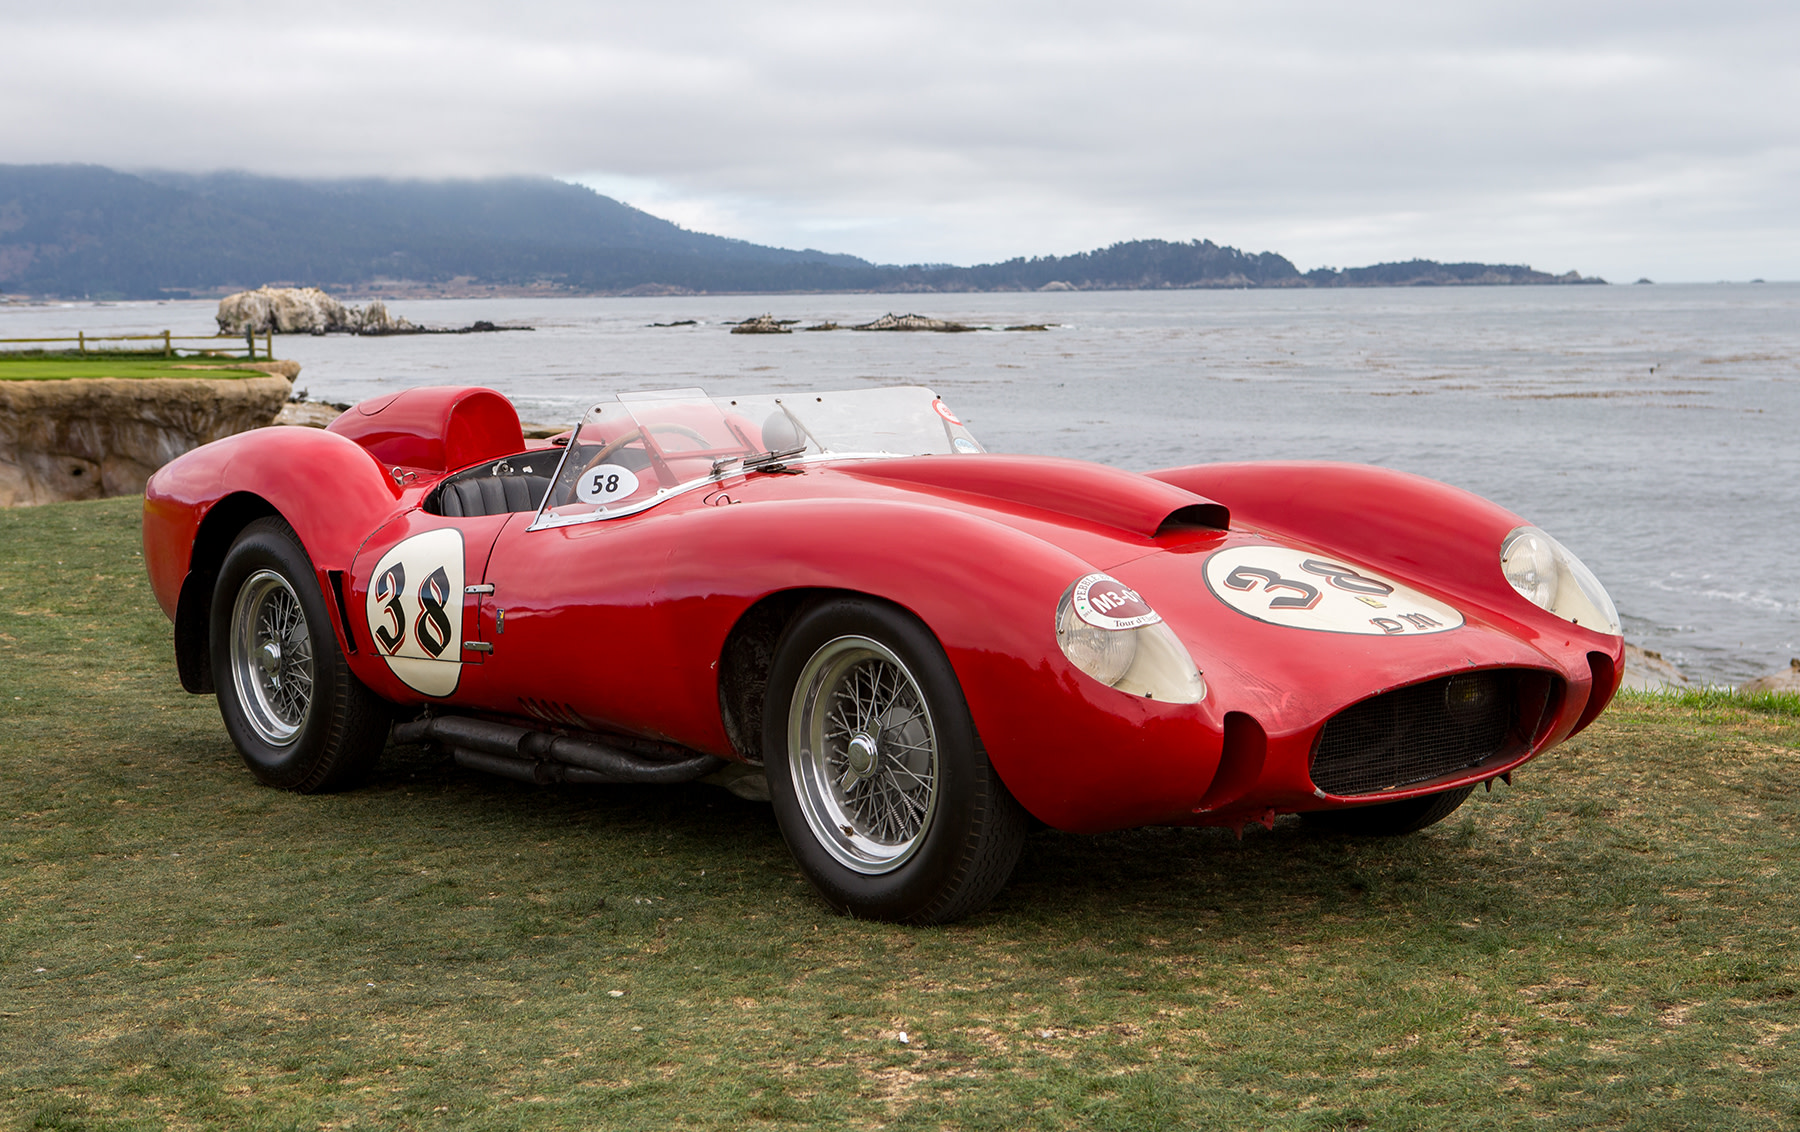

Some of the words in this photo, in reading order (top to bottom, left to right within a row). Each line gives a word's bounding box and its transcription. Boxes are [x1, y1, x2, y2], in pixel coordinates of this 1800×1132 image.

[591, 474, 620, 495] 58
[1076, 575, 1098, 602] PEBBLE
[1223, 558, 1395, 611] 38
[374, 561, 452, 660] 38
[1113, 619, 1135, 628] Tour
